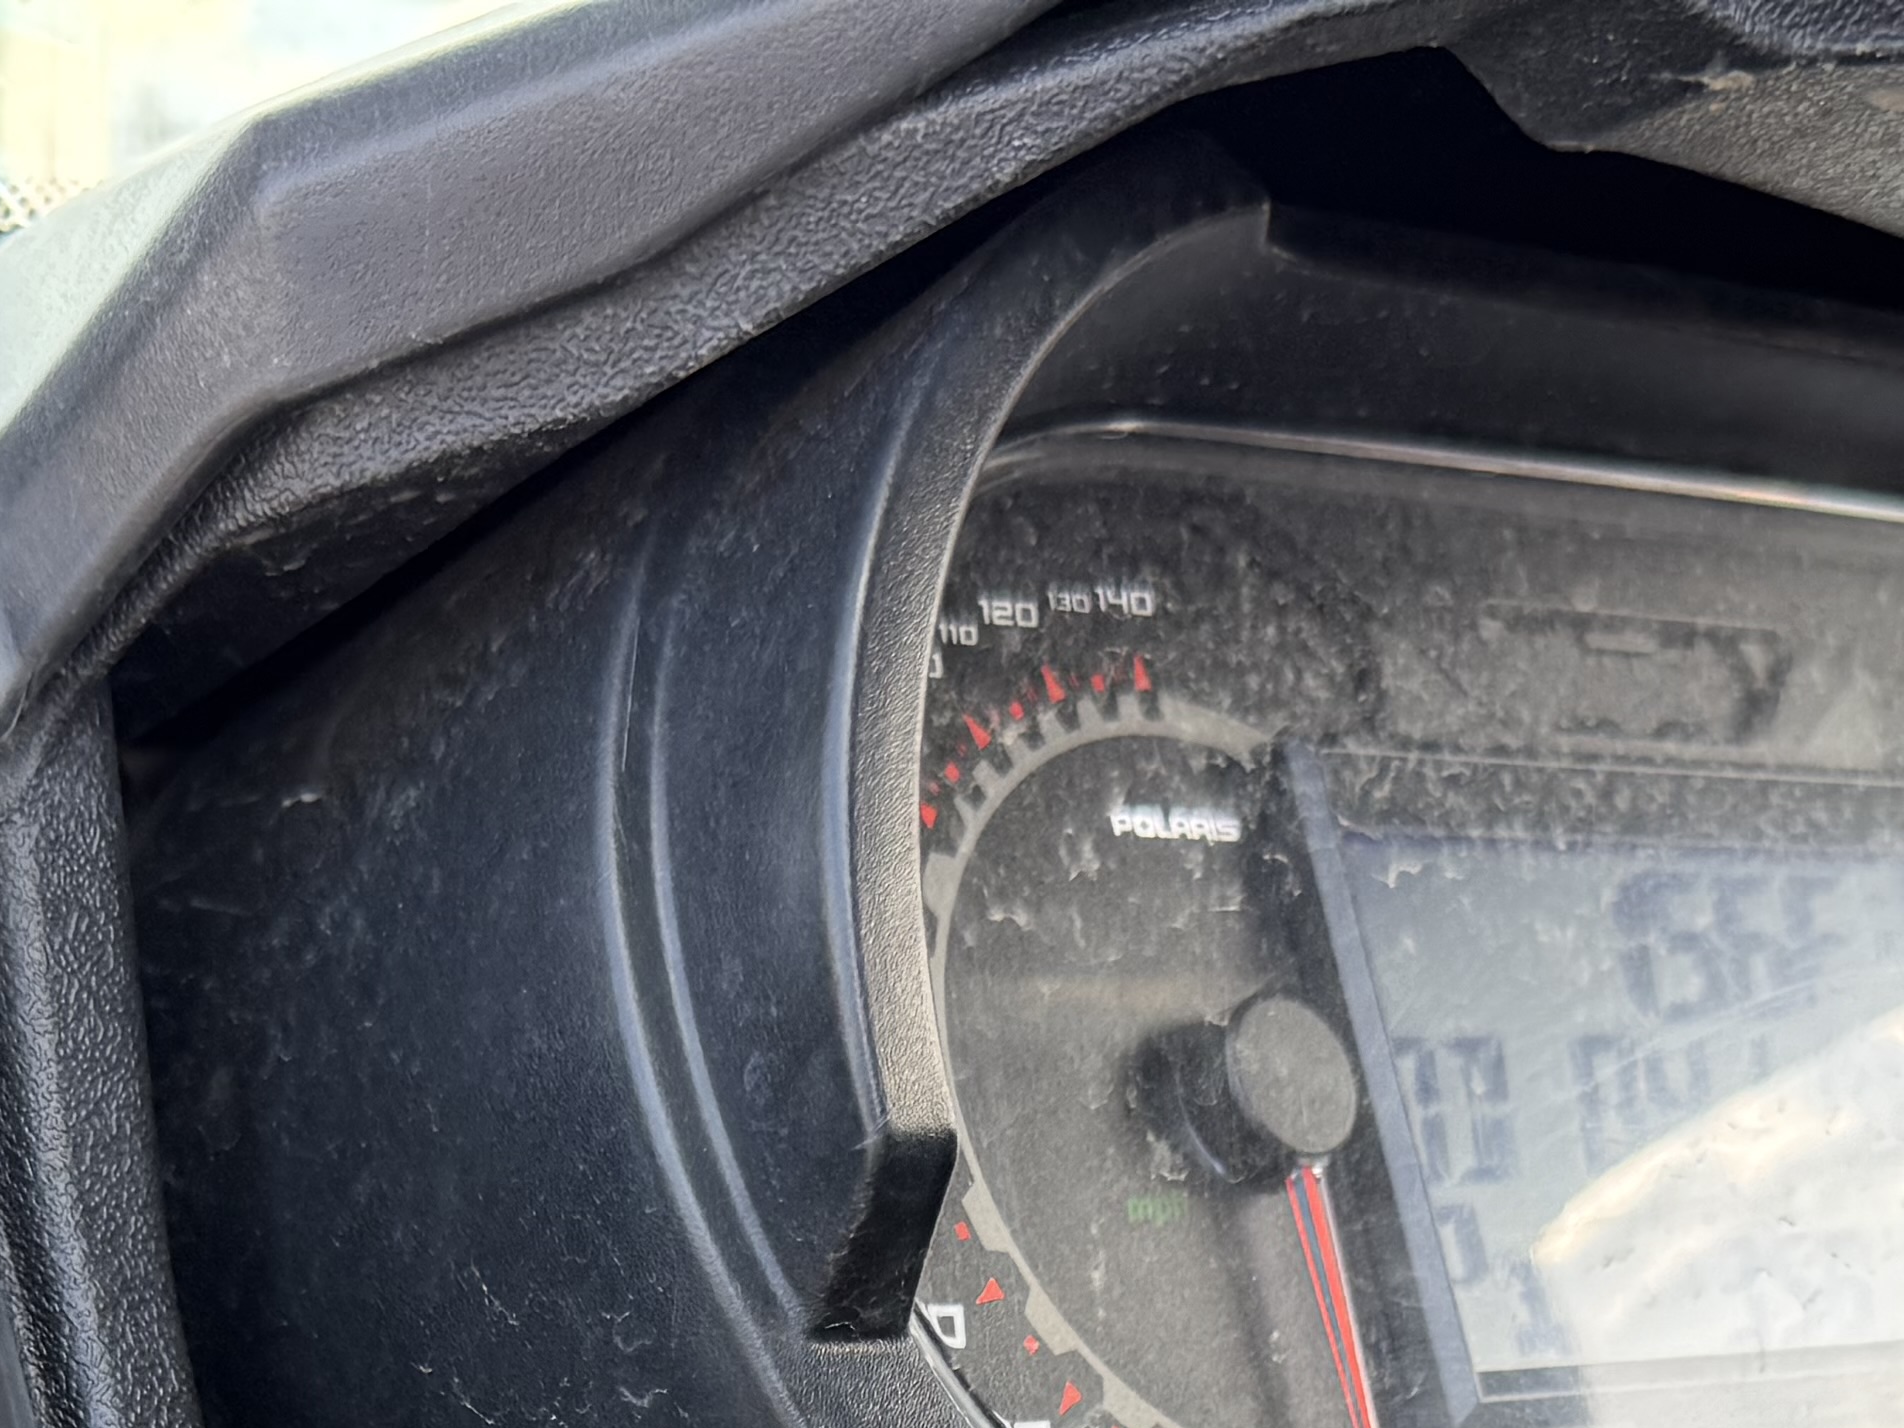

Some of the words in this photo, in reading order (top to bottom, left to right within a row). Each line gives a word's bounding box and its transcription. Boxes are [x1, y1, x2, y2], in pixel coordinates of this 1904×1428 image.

[977, 596, 1040, 628] 120
[1047, 588, 1091, 614] 130
[1095, 584, 1156, 617] 140
[938, 620, 979, 646] 110
[1109, 808, 1242, 844] POLARIS
